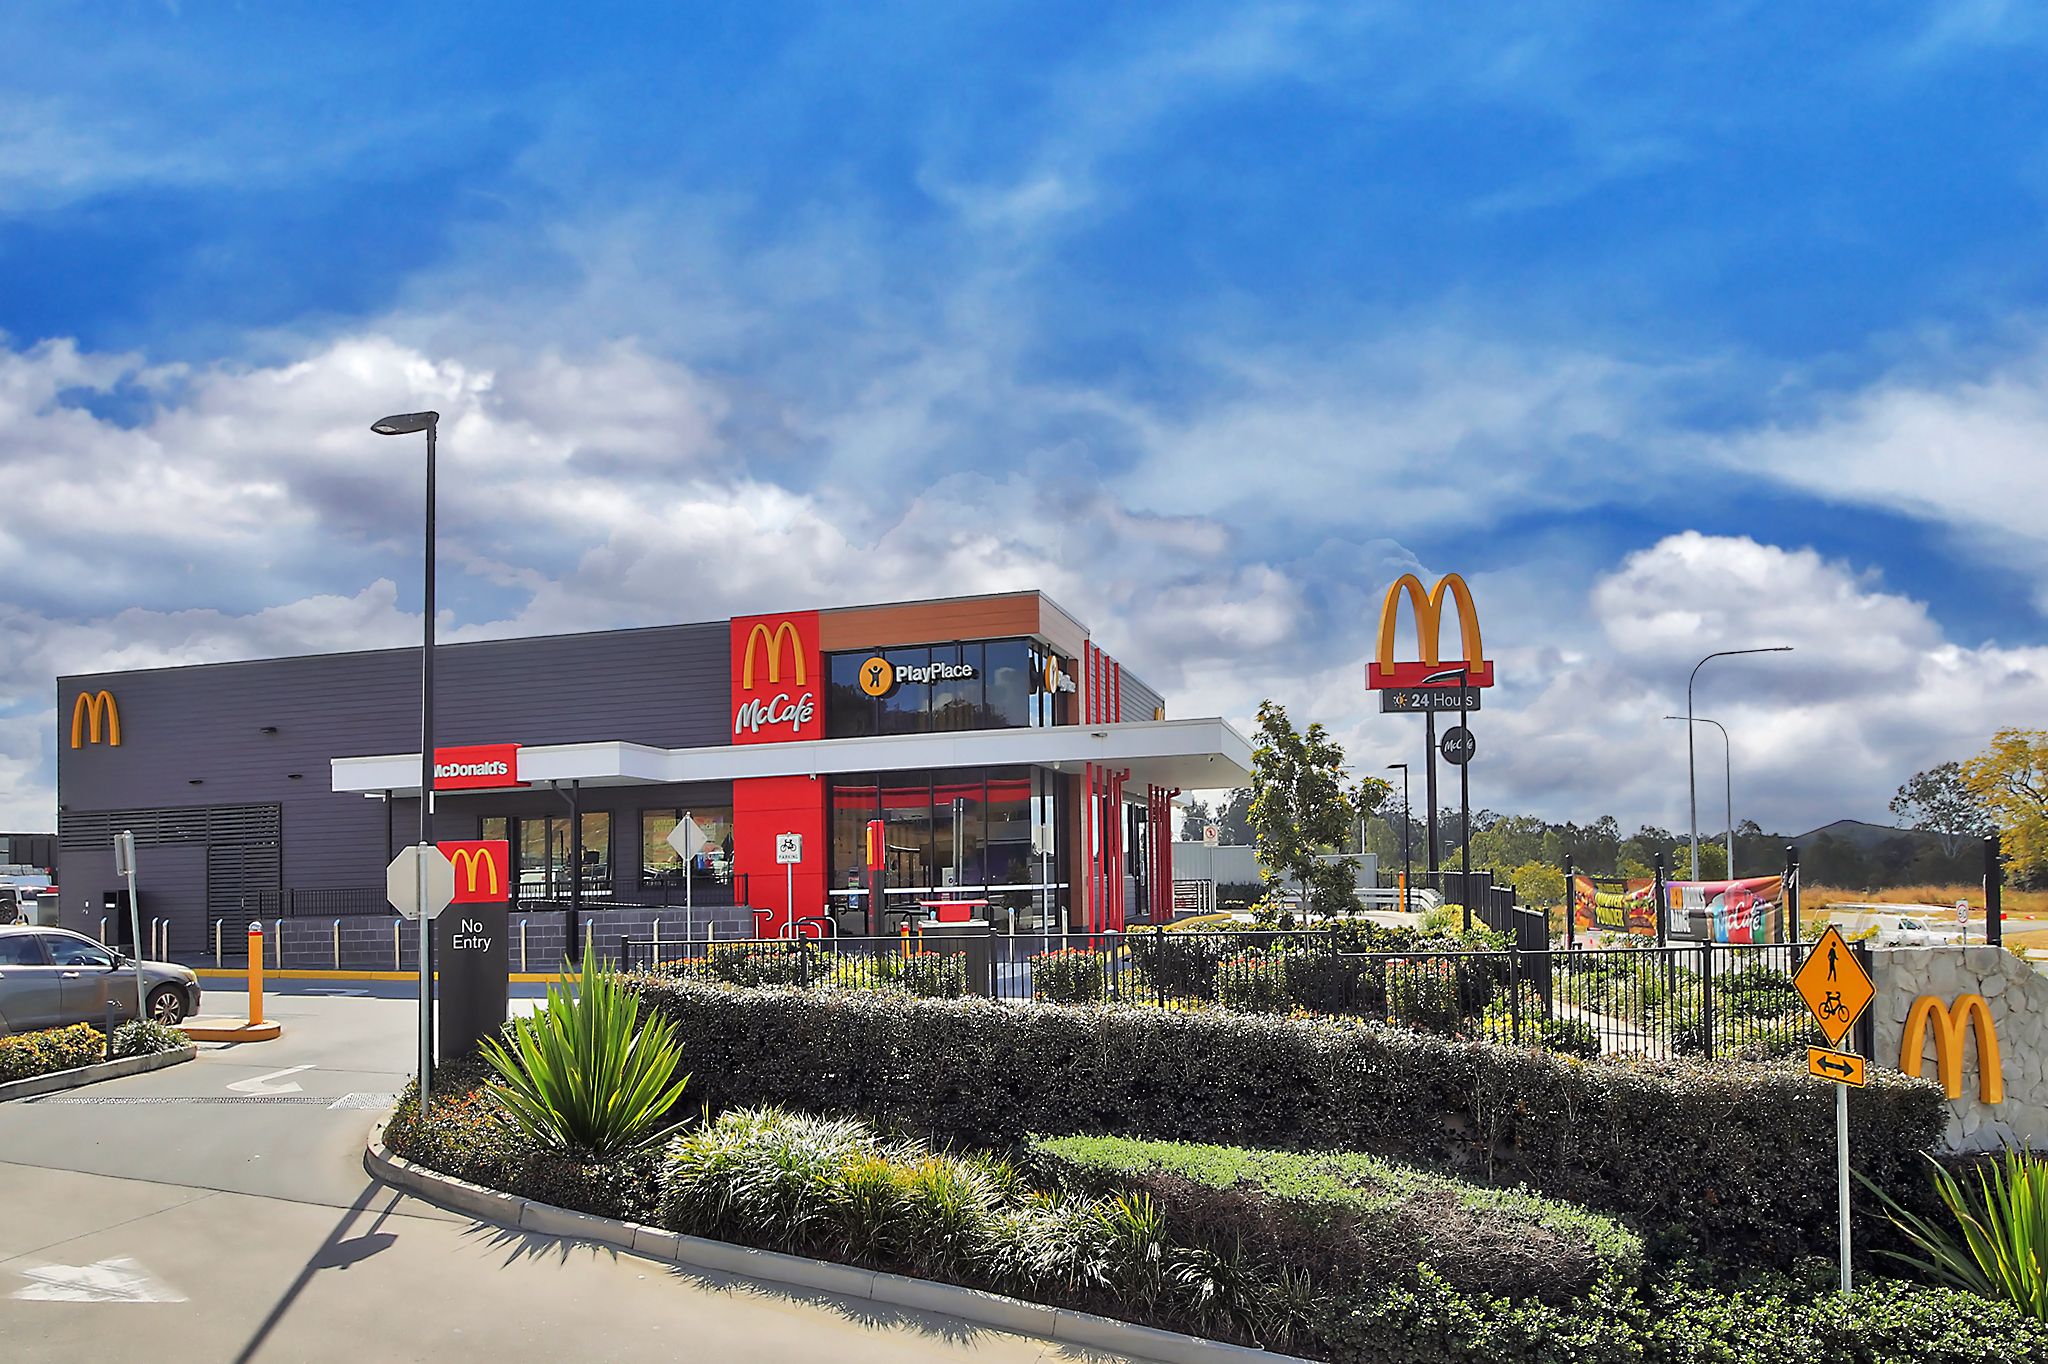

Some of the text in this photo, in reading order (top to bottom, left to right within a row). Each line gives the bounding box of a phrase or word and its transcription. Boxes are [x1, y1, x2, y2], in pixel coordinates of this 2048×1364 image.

[896, 662, 973, 684] PlayPlace
[1411, 692, 1473, 707] 24 Hous
[735, 692, 814, 734] McCafé
[461, 918, 483, 933] No
[453, 934, 491, 952] Entry
